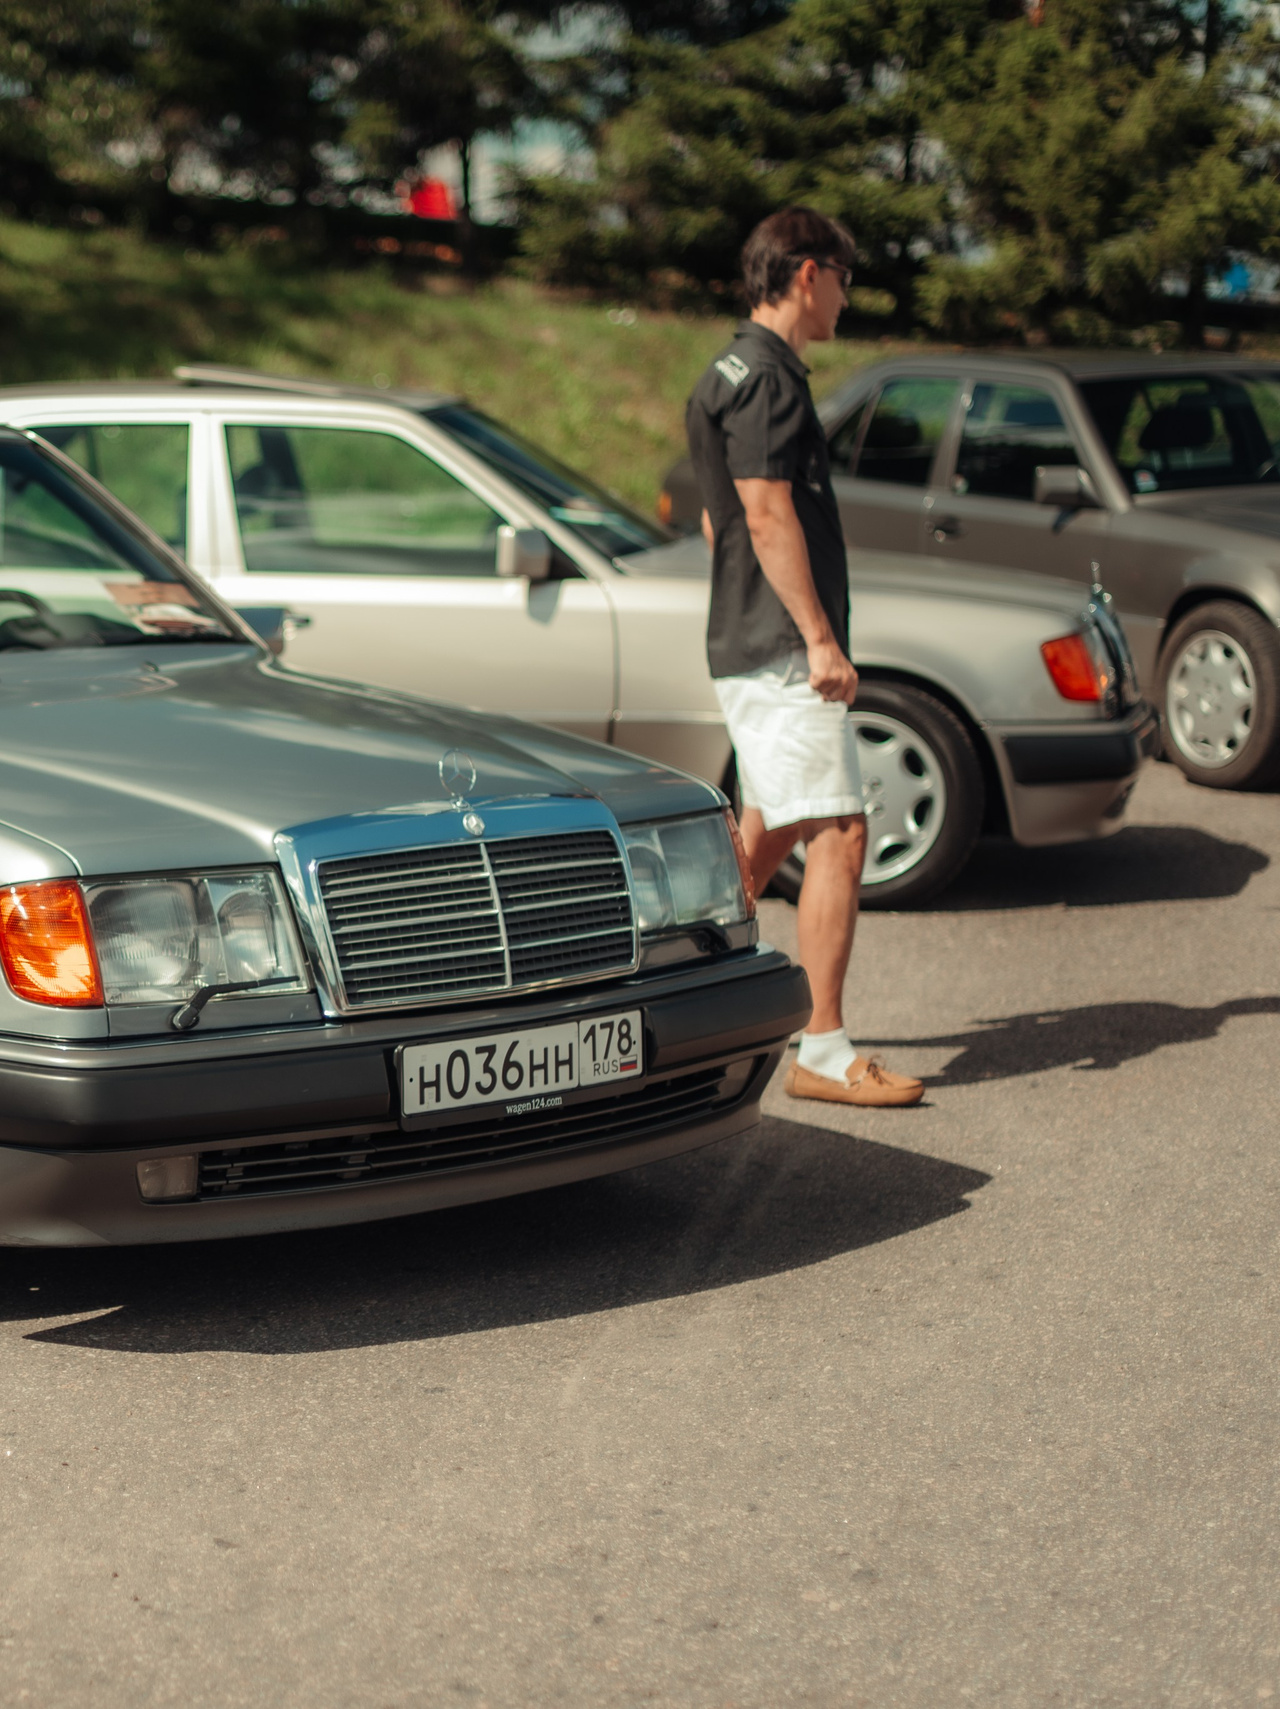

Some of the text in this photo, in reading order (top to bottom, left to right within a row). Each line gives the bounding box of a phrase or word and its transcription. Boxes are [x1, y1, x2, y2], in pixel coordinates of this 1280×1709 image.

[583, 1018, 633, 1062] 178
[593, 1060, 619, 1077] RUS
[505, 1096, 563, 1115] wagen124.com
